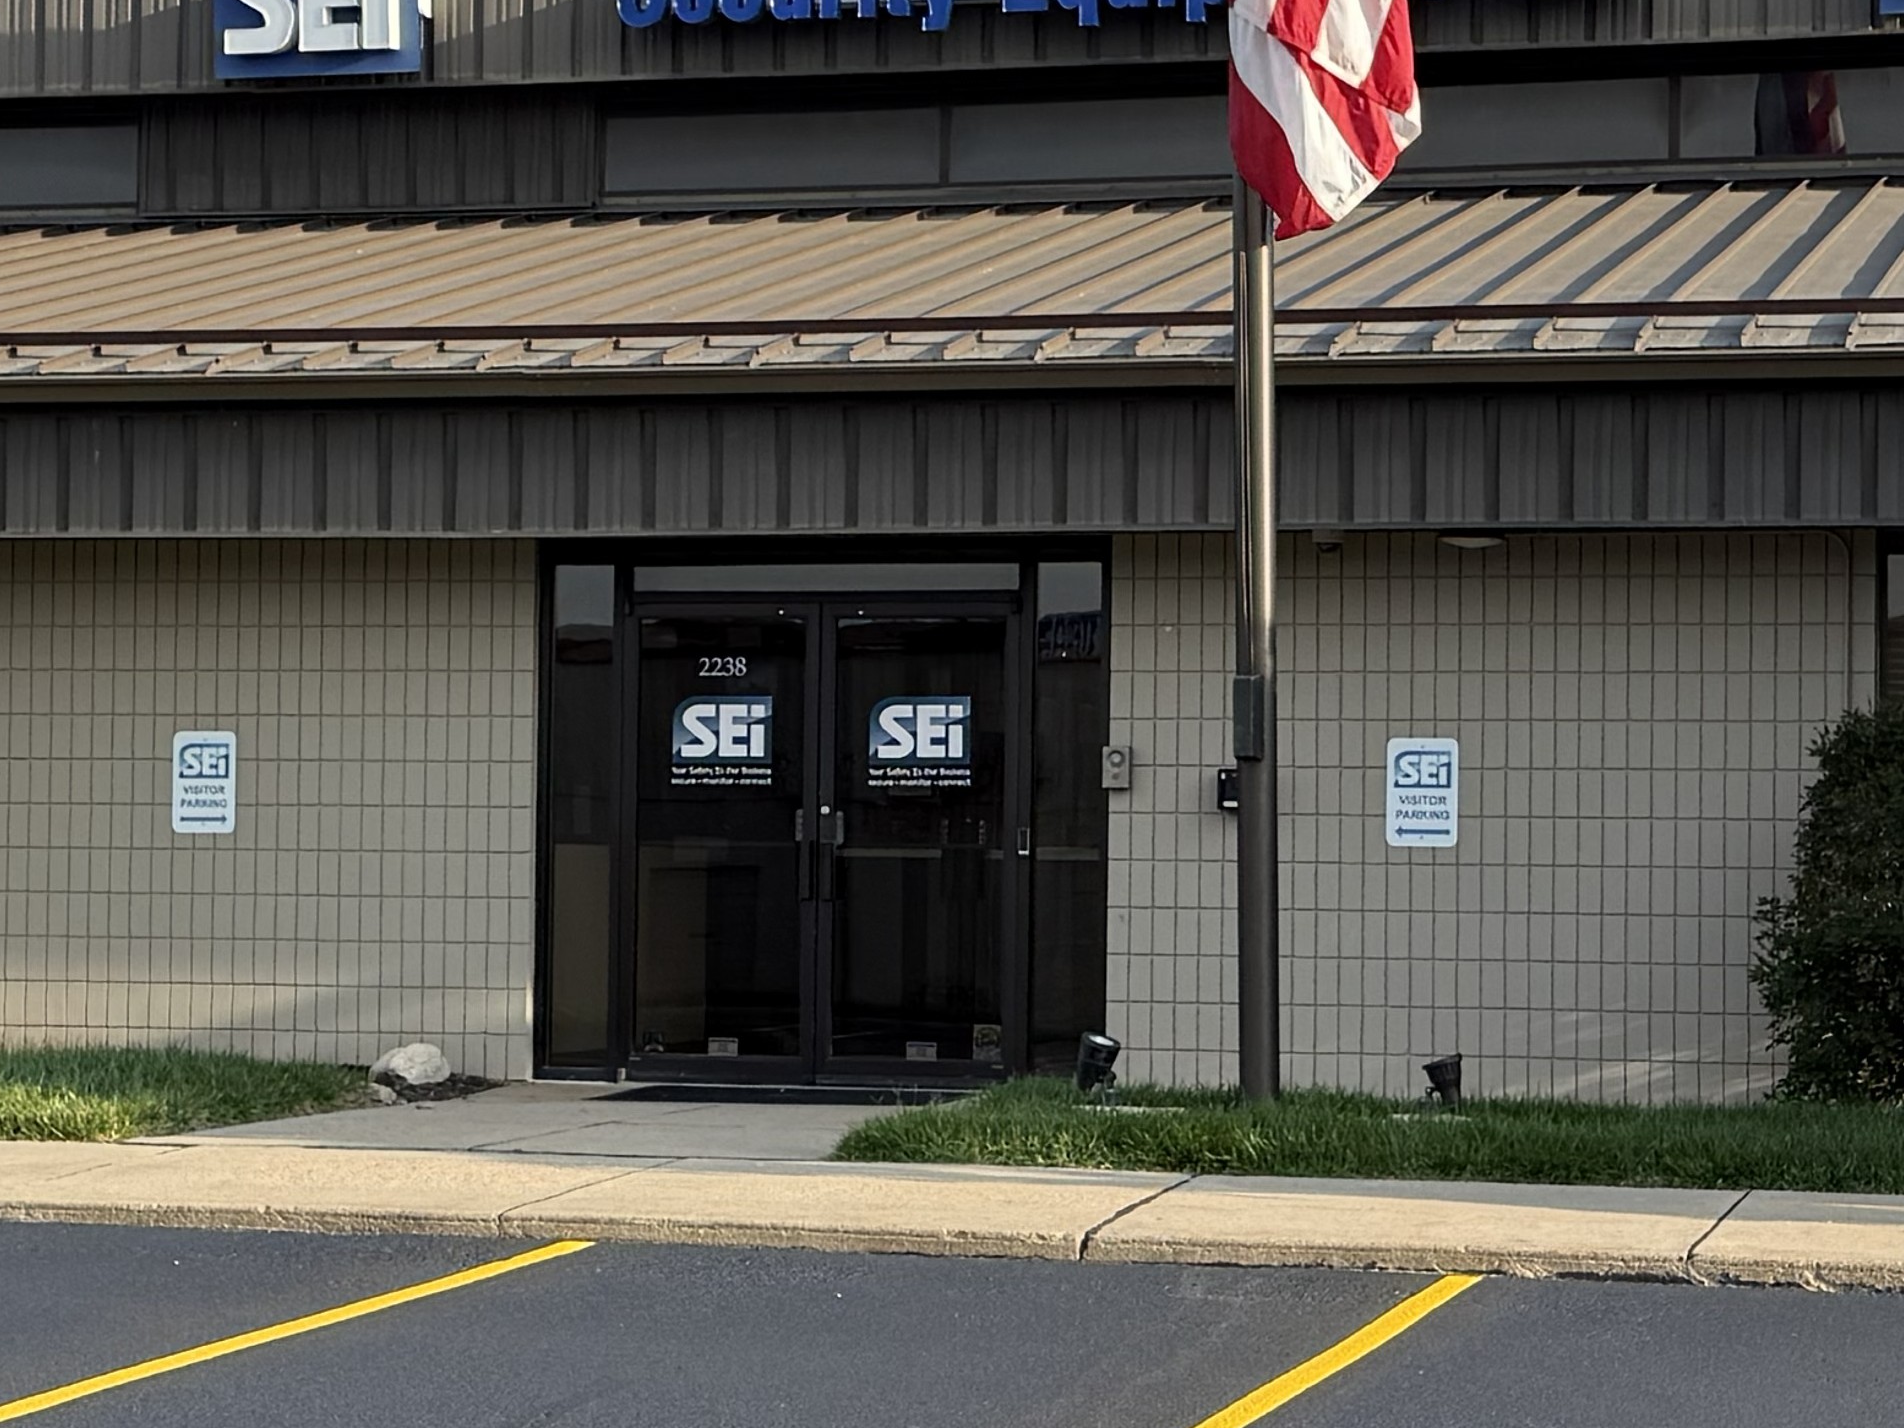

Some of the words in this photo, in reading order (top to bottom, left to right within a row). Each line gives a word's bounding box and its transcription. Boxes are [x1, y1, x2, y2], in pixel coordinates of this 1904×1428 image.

[699, 656, 747, 677] 2238
[183, 785, 225, 795] VISITOR
[180, 798, 227, 808] PARKING
[1399, 795, 1447, 805] VISITOR
[1396, 810, 1450, 820] PARKING
